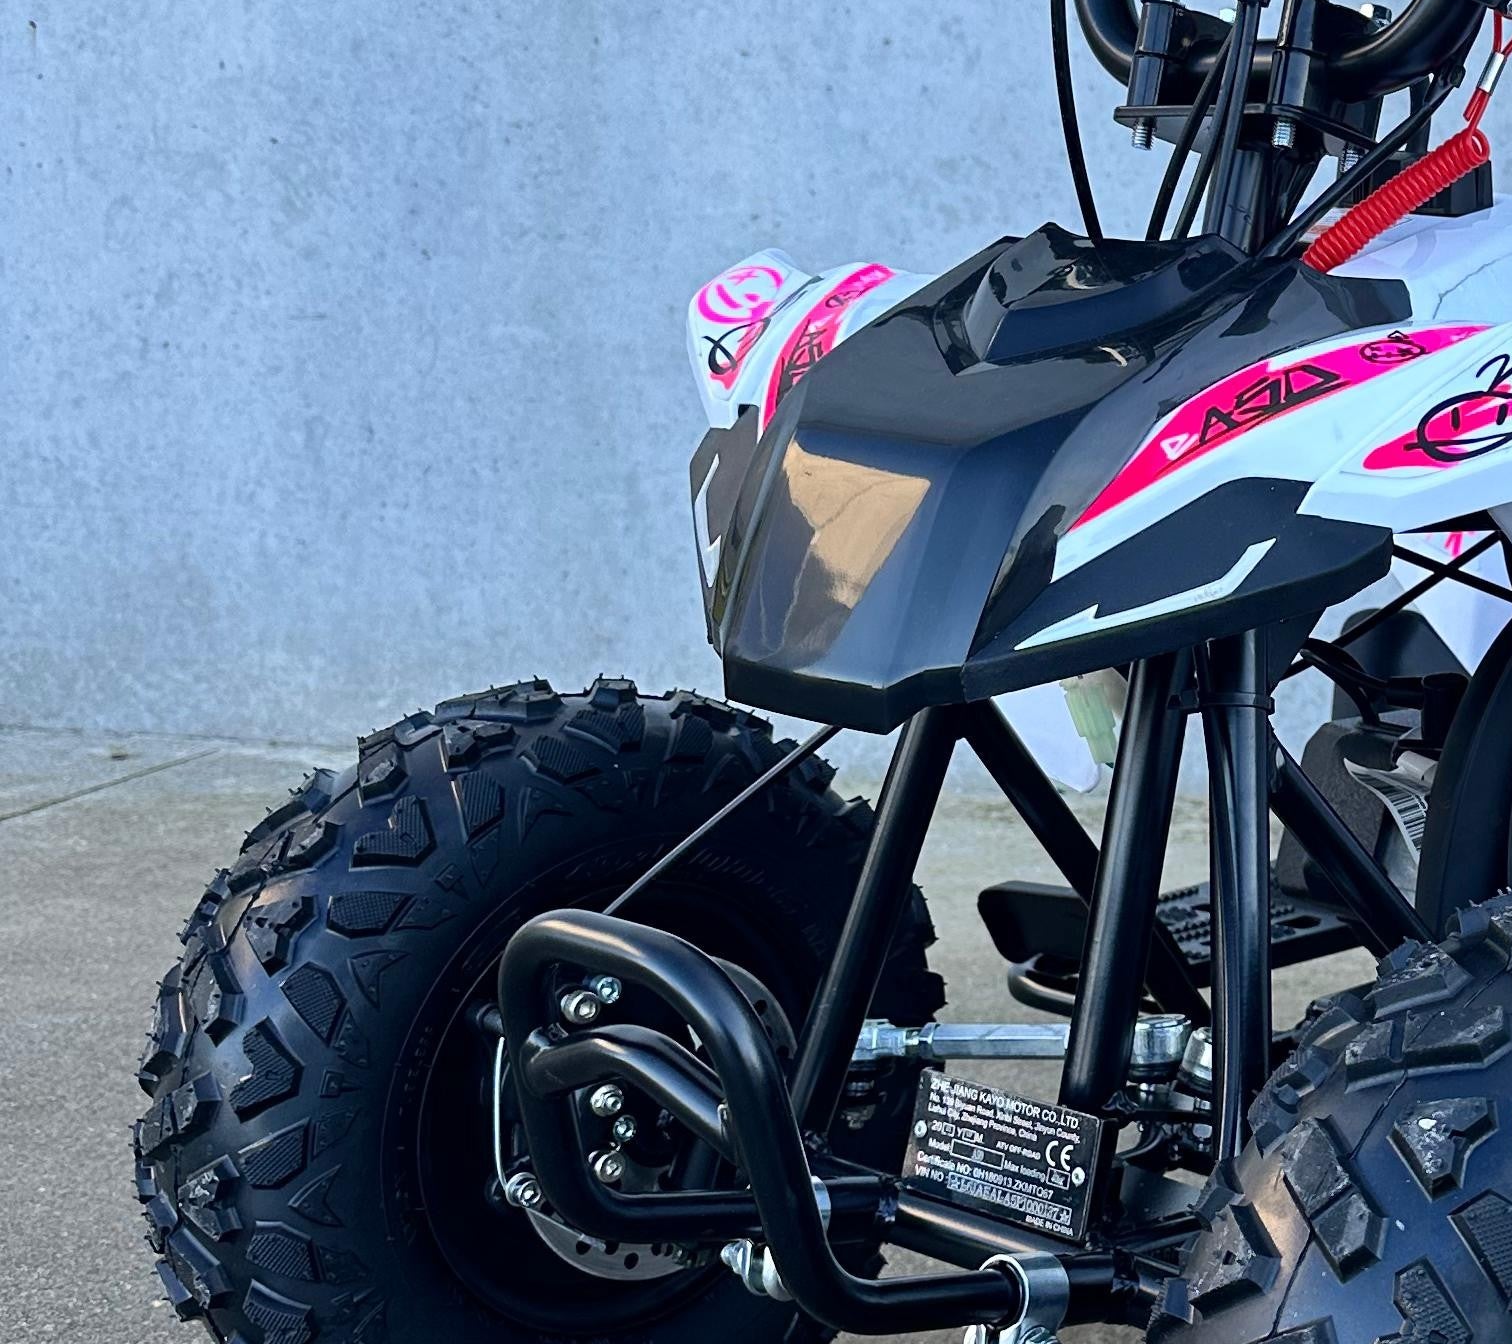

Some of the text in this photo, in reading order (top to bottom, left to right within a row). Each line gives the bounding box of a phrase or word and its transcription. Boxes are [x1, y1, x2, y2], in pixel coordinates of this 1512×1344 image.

[979, 1090, 1005, 1109] KAYO
[1005, 1098, 1041, 1119] MOTOR
[916, 1150, 956, 1171] Certificate
[1045, 1140, 1074, 1172] CE
[914, 1163, 931, 1178] VIN
[1004, 1159, 1020, 1173] Max
[1020, 1164, 1046, 1183] loading
[1025, 1214, 1045, 1228] MADE
[1053, 1223, 1074, 1236] CHINA
